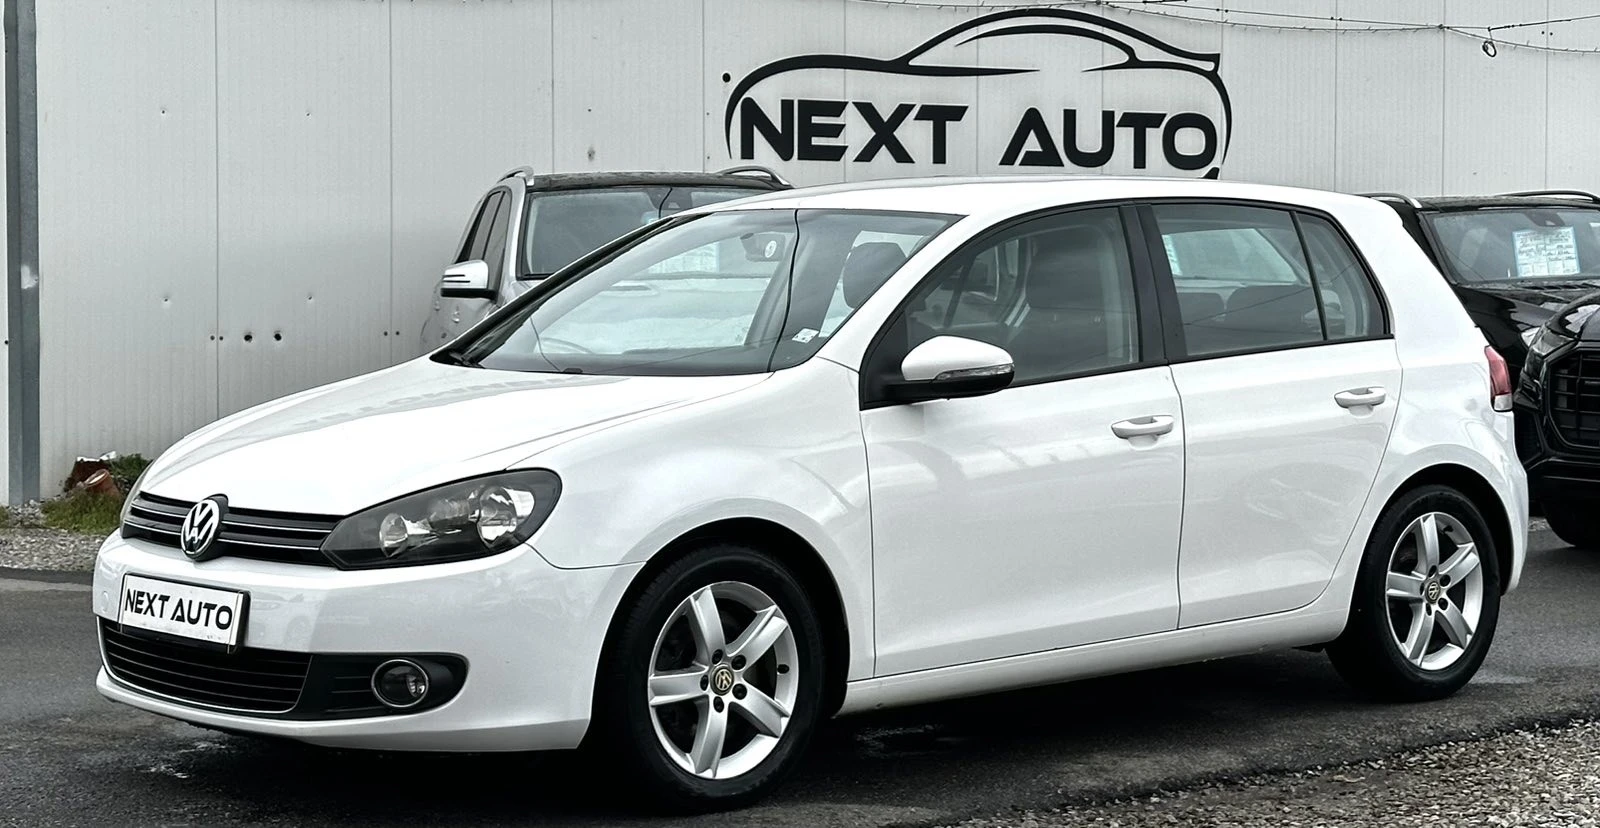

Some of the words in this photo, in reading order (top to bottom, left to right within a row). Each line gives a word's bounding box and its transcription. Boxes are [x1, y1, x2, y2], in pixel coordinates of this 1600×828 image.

[740, 96, 969, 165] NEXT
[999, 106, 1218, 170] AUTO
[124, 588, 171, 619] NEXT
[170, 597, 233, 630] AUTO
